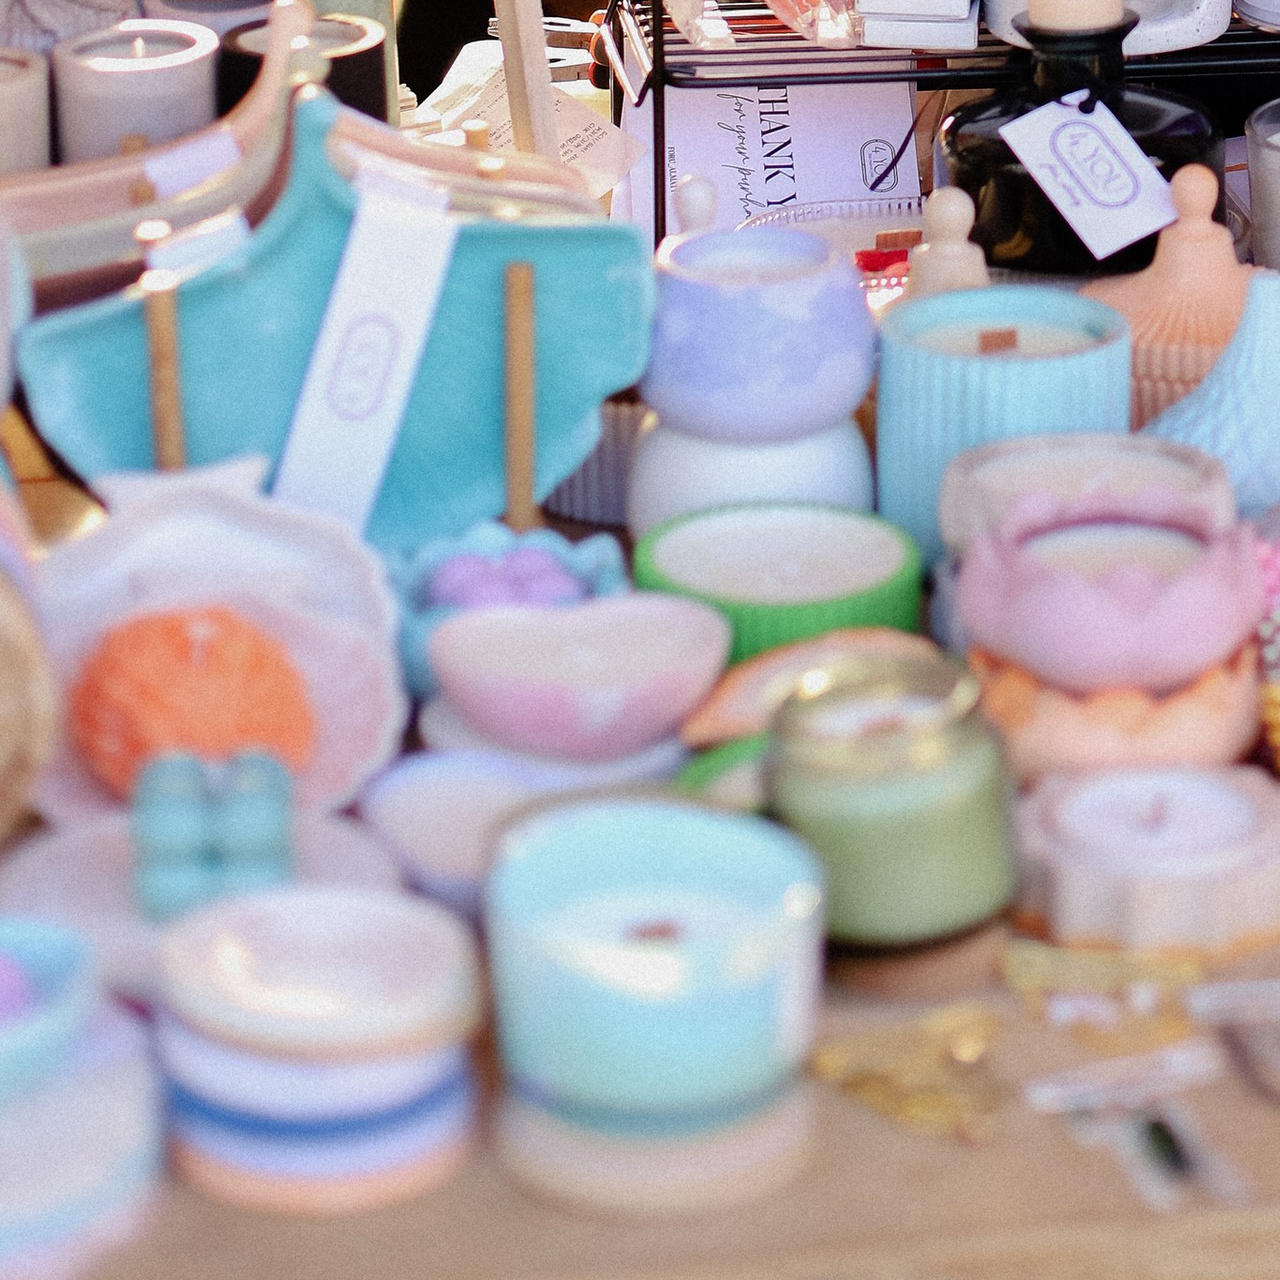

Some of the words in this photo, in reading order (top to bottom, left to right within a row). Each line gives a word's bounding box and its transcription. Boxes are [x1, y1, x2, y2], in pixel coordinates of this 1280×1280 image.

[716, 93, 754, 122] for
[717, 122, 750, 164] your
[757, 86, 796, 184] THANK
[872, 146, 887, 154] 4
[721, 164, 766, 219] purha
